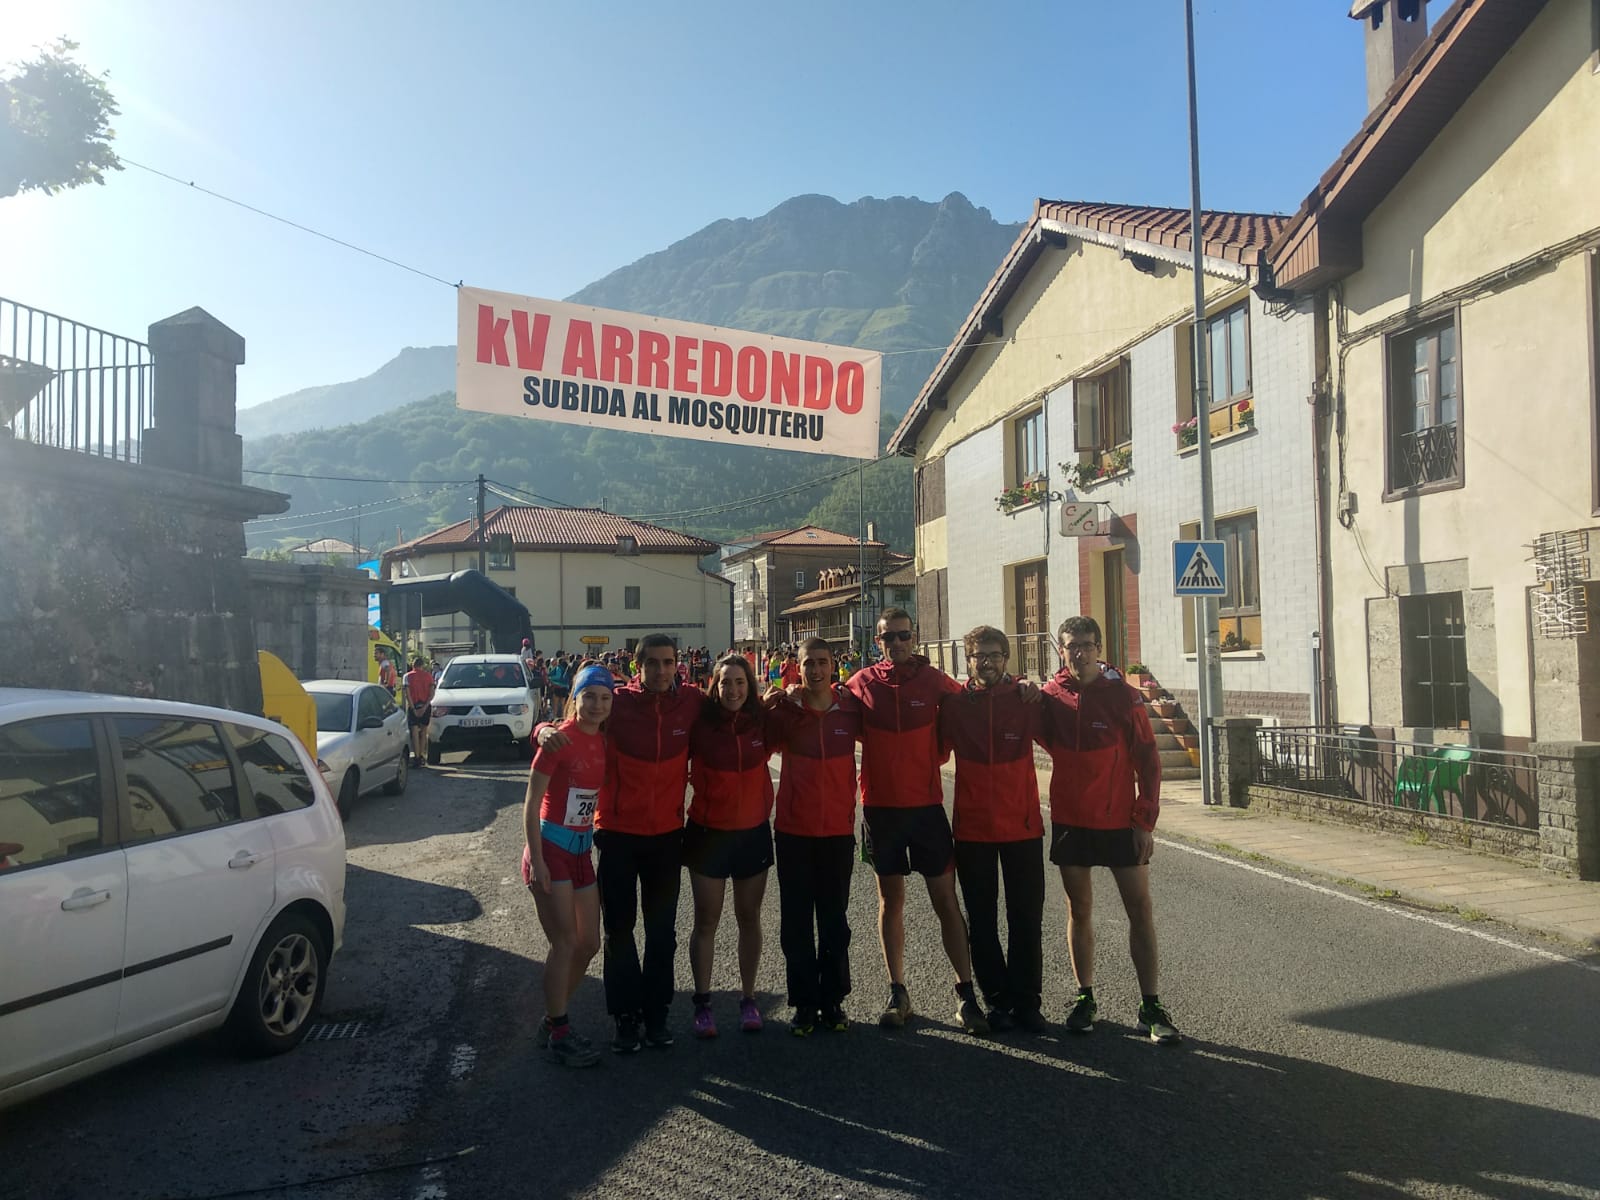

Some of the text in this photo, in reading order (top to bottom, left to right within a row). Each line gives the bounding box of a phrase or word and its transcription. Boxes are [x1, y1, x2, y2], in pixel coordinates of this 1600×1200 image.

[561, 318, 864, 414] ARREDONDO
[523, 375, 823, 441] SUBIDA AL MOSQUITERU
